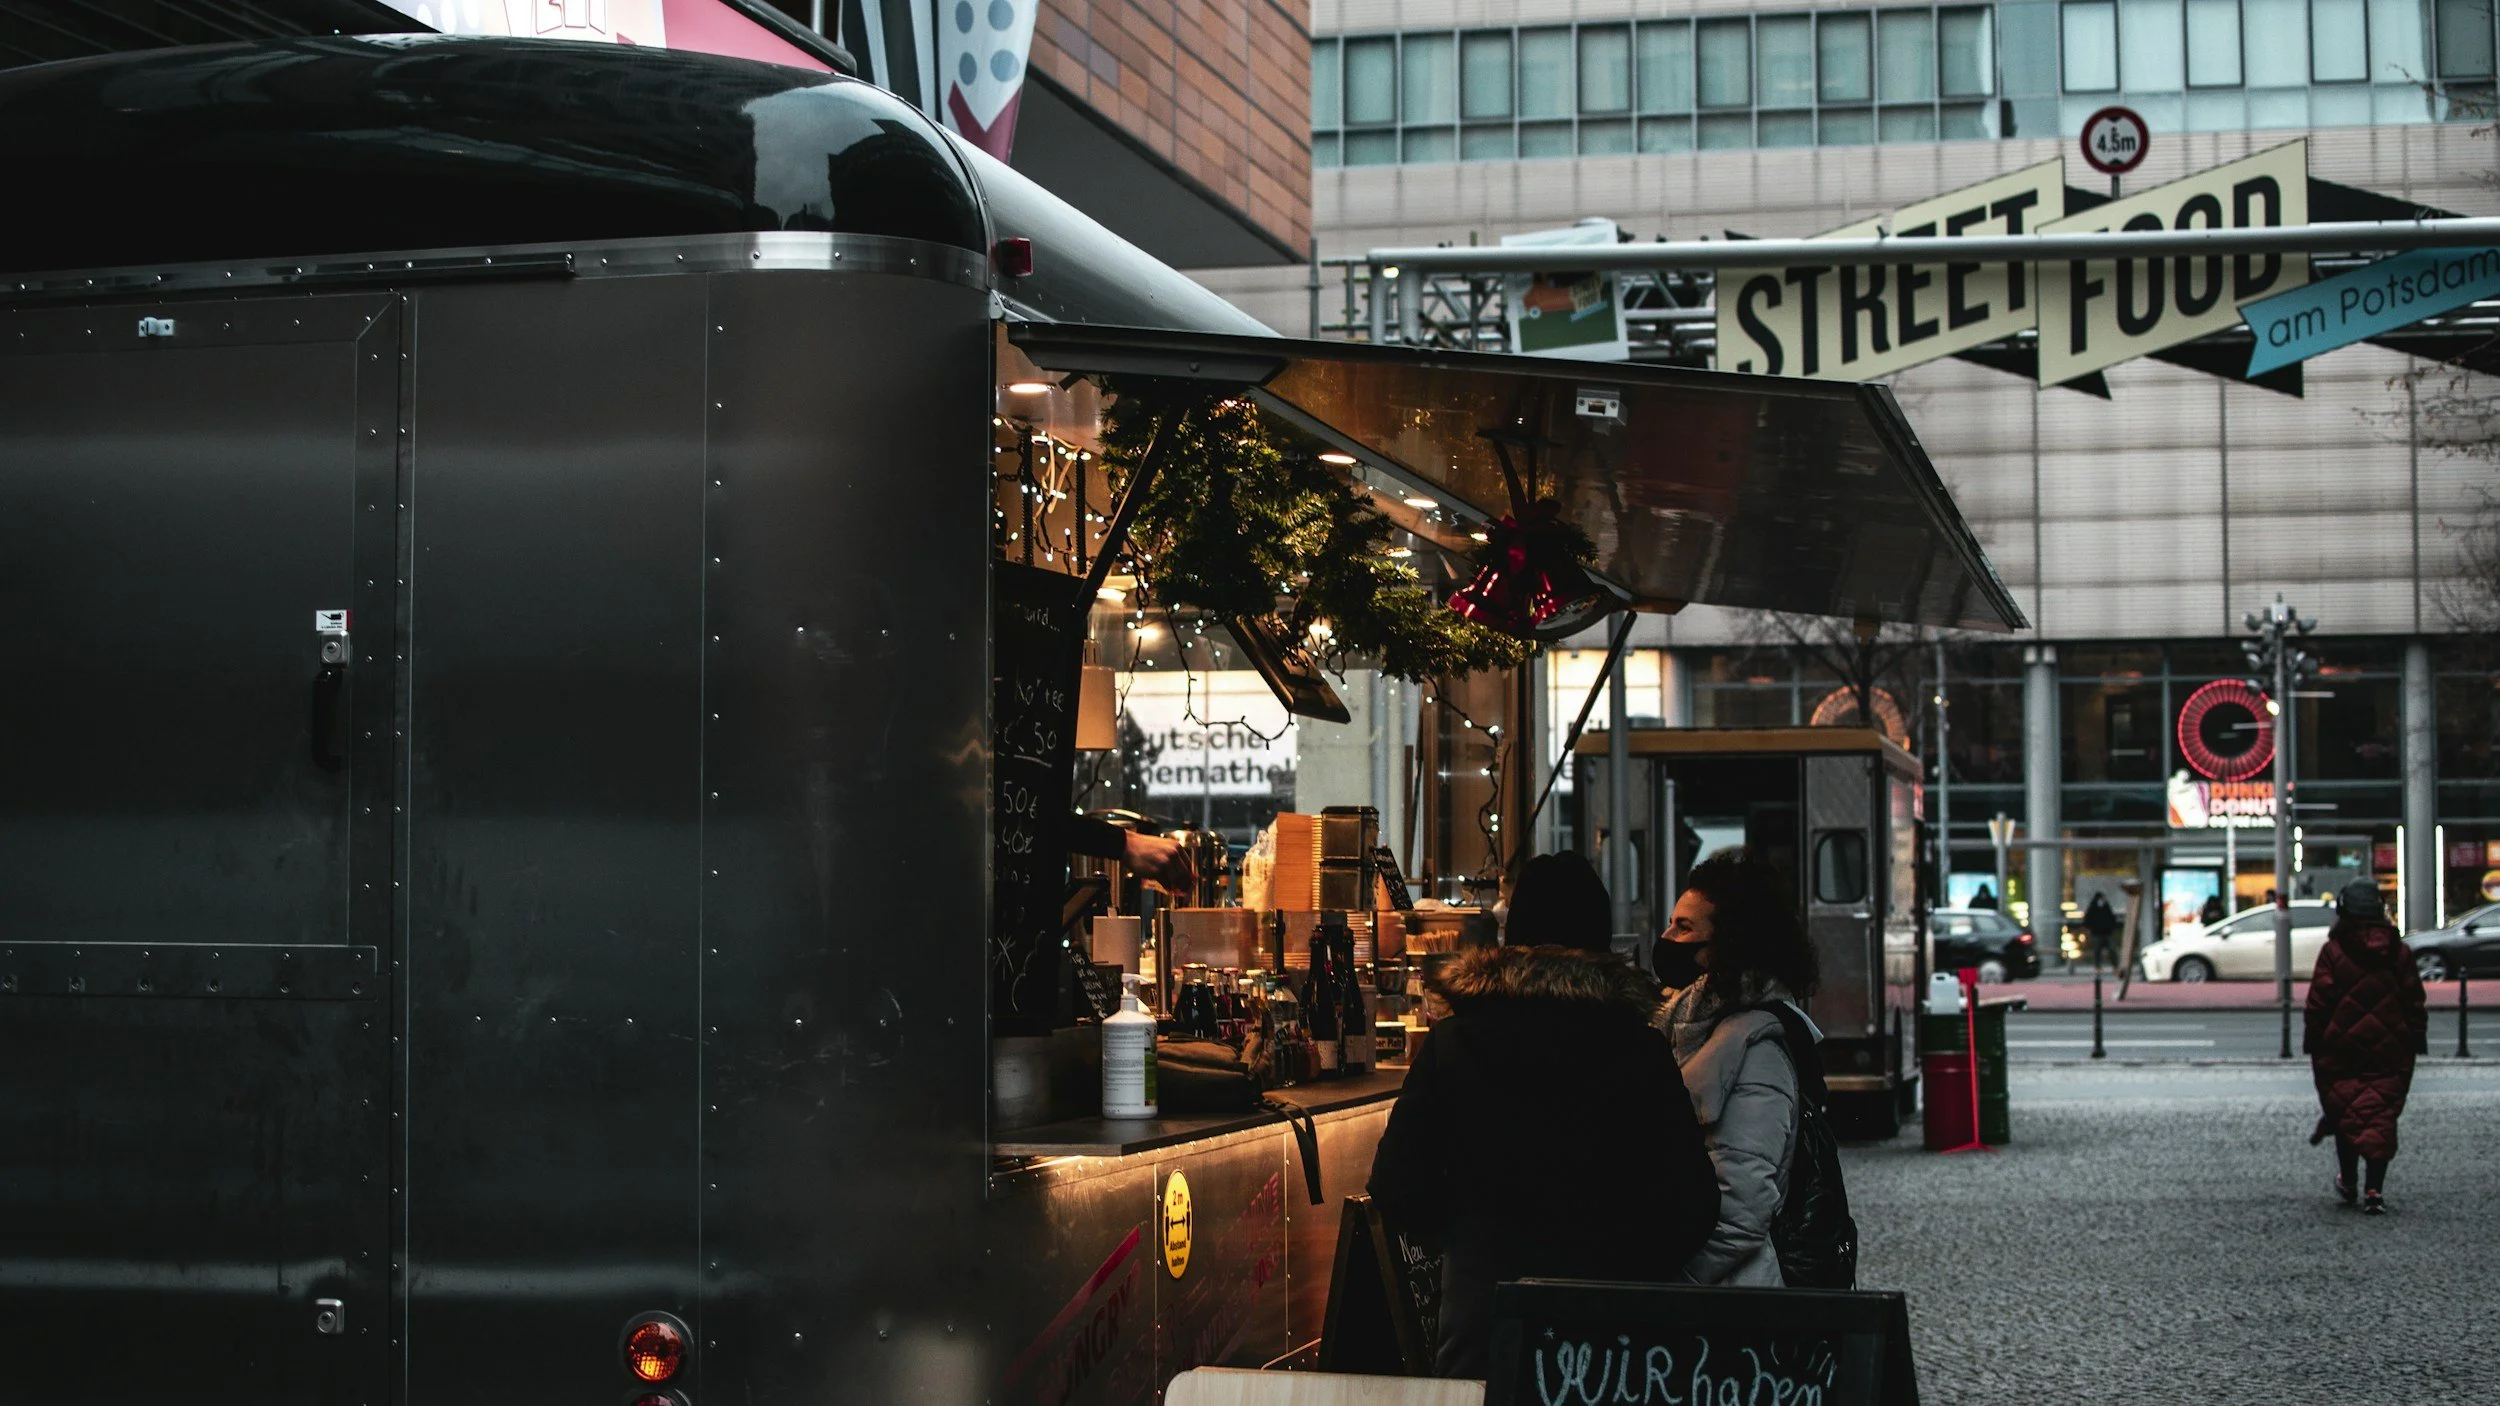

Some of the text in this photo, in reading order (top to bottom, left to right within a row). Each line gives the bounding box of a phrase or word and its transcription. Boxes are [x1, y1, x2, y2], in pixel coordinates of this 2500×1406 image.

[1736, 174, 2282, 376] STREET FOOD
[2267, 248, 2500, 348] am Potsdam
[1148, 724, 1264, 751] utsche
[2210, 782, 2274, 798] DUNKI
[2210, 798, 2277, 815] DONUT
